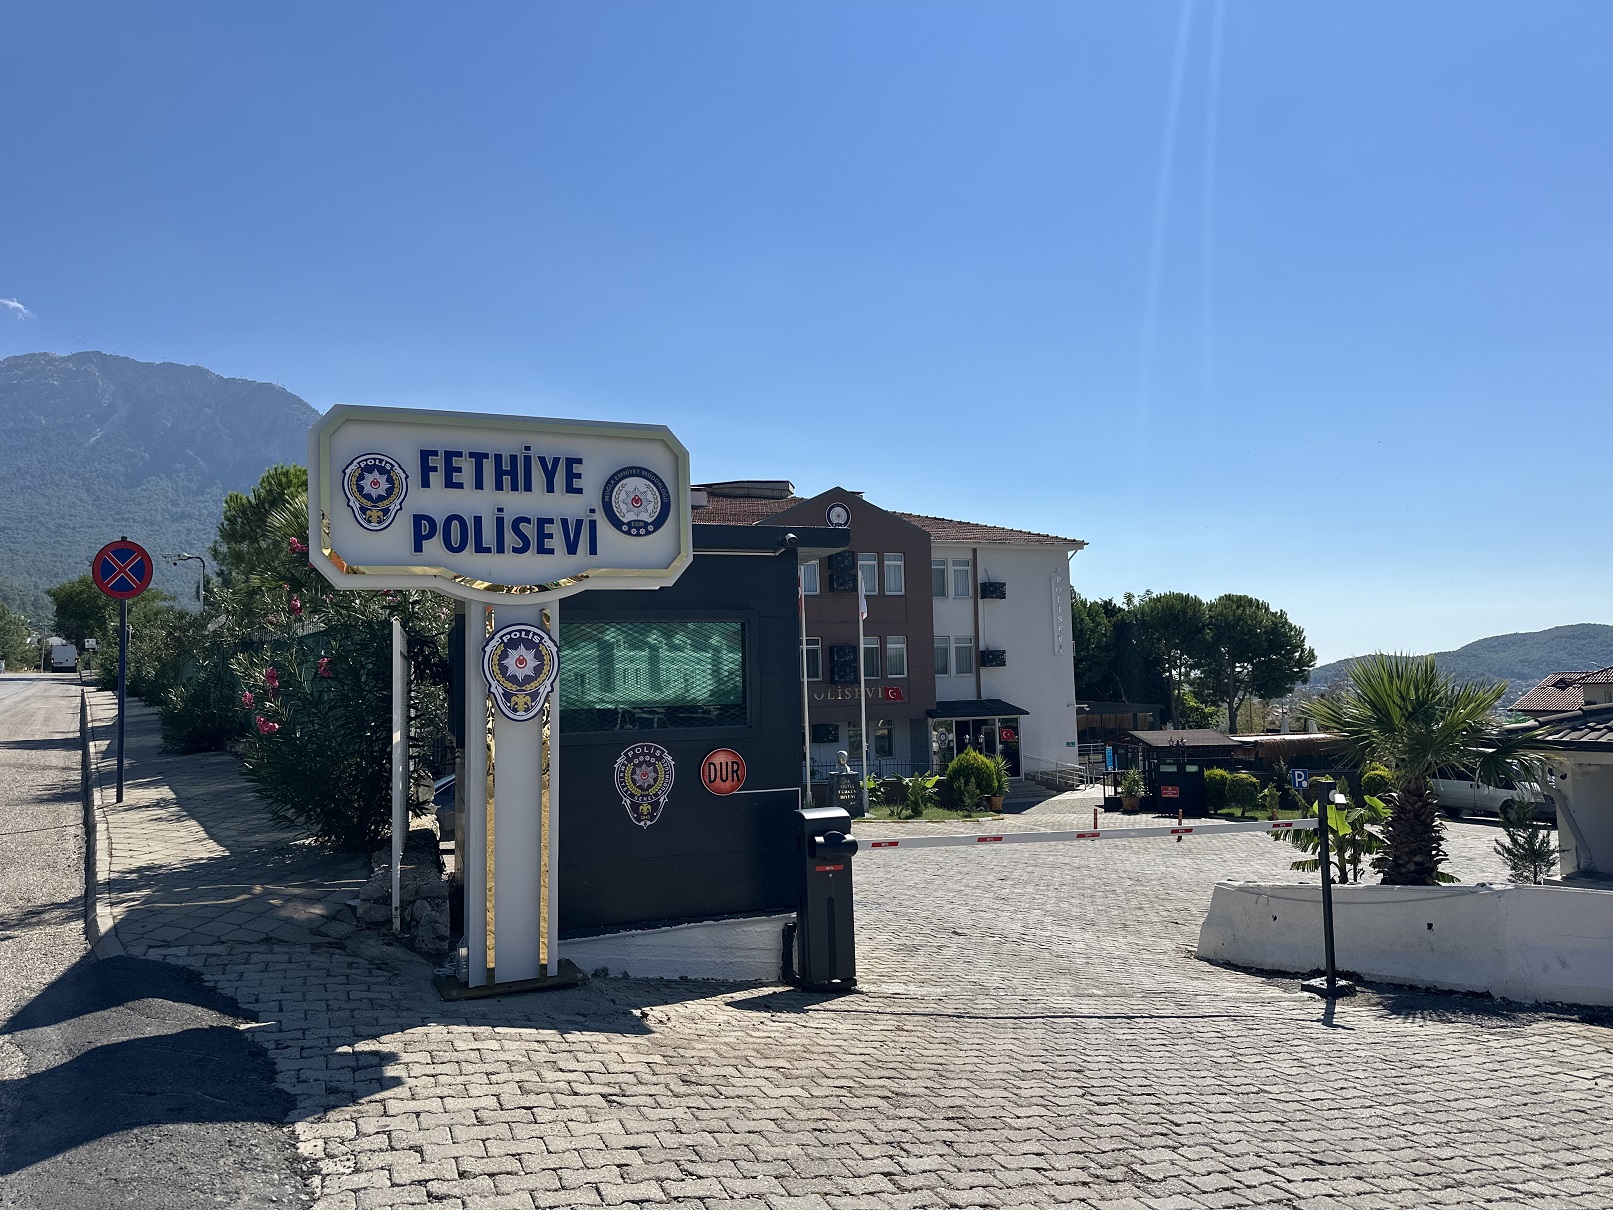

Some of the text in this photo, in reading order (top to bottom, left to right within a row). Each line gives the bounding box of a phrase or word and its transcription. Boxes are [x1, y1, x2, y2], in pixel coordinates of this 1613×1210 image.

[360, 459, 392, 470] POLİS
[419, 445, 584, 495] FETHİYE
[412, 507, 599, 556] POLİSEVİ
[502, 631, 541, 643] POLİS
[804, 684, 883, 701] OLİSEVİ
[627, 746, 662, 758] POLİS
[707, 761, 741, 784] DUR
[1295, 770, 1305, 788] P
